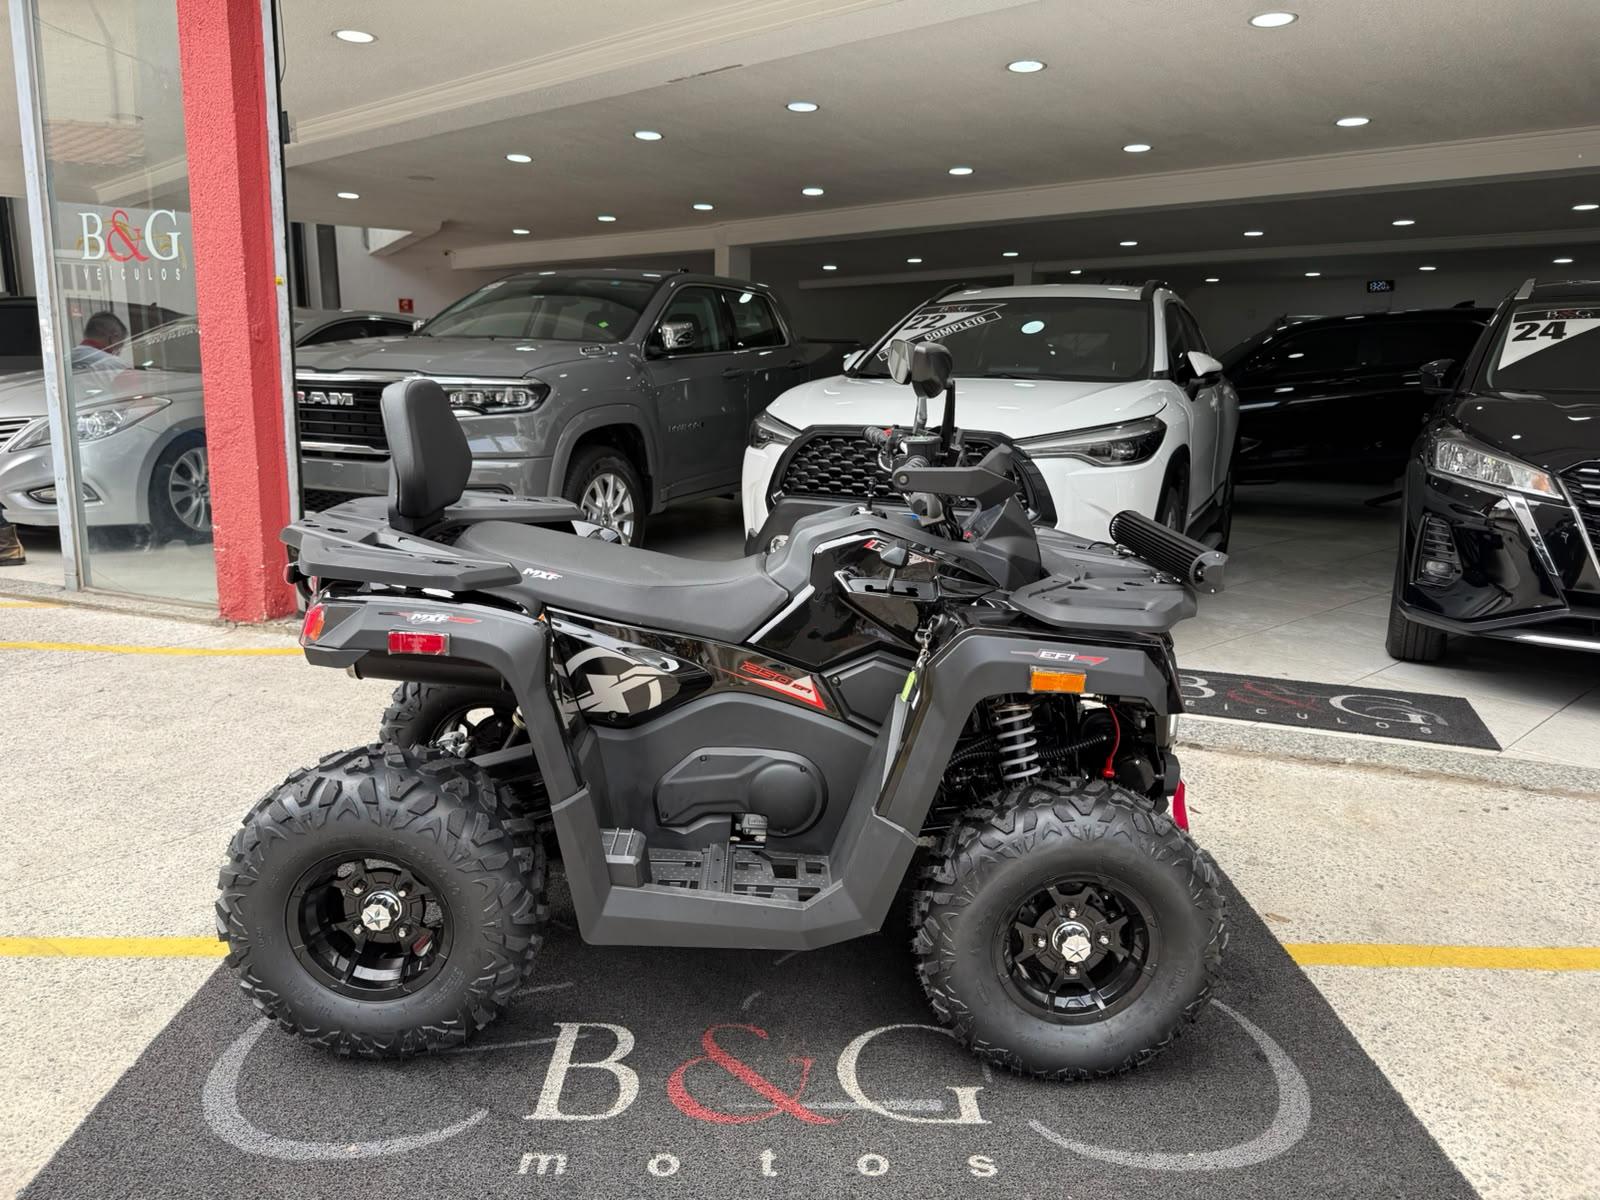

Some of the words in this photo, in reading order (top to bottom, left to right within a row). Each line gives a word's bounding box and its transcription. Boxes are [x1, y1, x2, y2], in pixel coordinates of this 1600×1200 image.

[78, 208, 181, 262] B&G
[903, 314, 947, 330] 22
[924, 316, 986, 341] COMPLETO
[1512, 321, 1567, 342] 24
[522, 567, 563, 580] MXF
[1039, 650, 1076, 661] EFI
[740, 660, 794, 686] 250
[523, 1021, 993, 1125] B&G
[518, 1149, 999, 1178] motos
